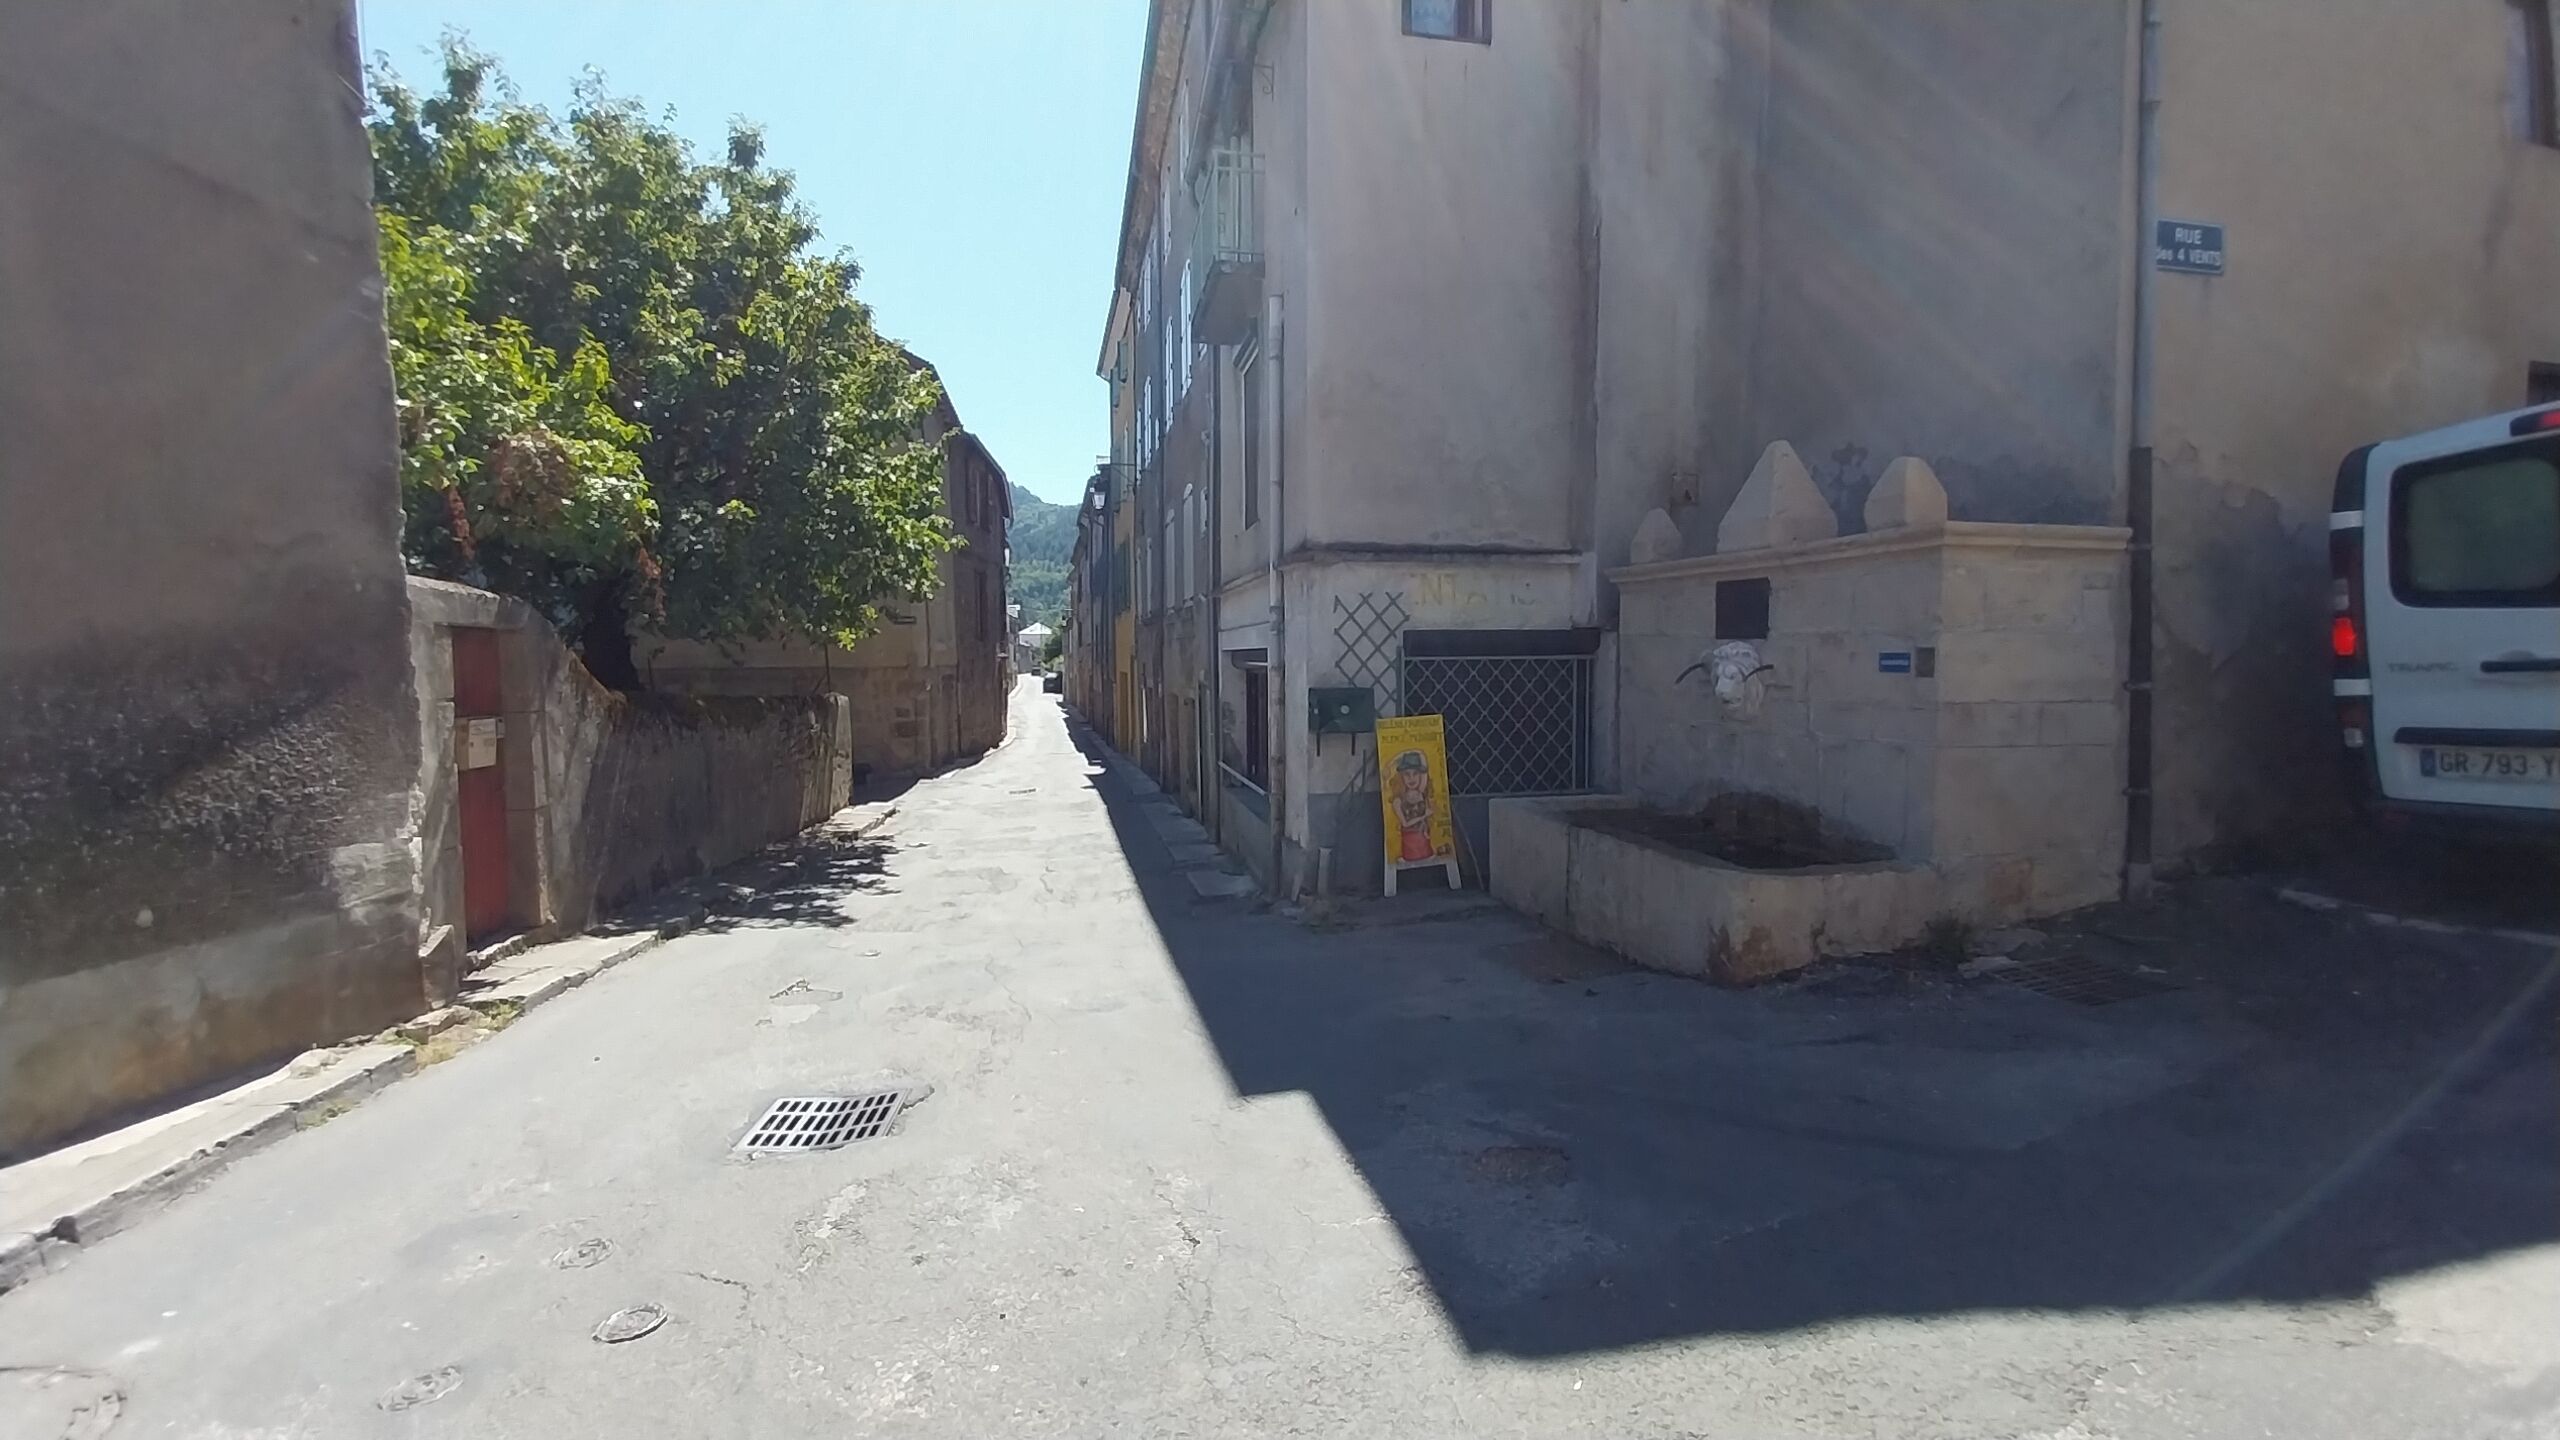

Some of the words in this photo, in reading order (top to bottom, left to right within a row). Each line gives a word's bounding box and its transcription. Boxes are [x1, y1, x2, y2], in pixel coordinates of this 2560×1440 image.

[2175, 227, 2202, 244] RUE
[2177, 247, 2185, 261] 4
[2189, 249, 2221, 266] VENTS
[2440, 753, 2560, 777] GR-793-Y
